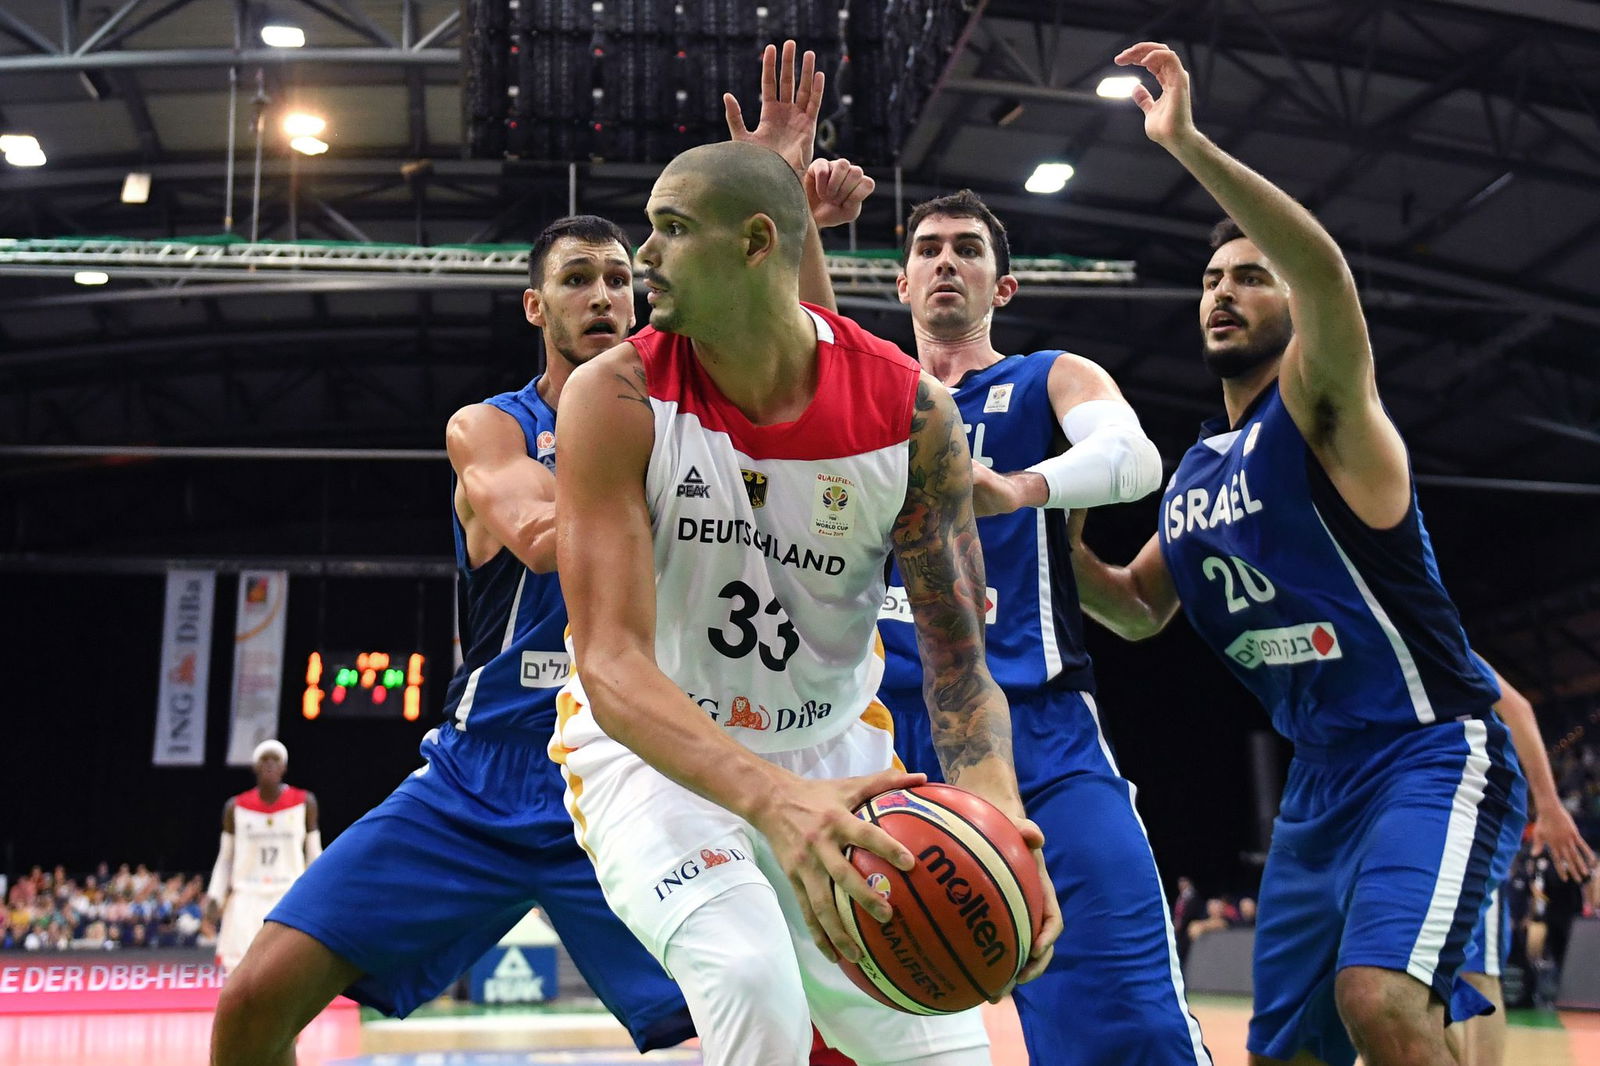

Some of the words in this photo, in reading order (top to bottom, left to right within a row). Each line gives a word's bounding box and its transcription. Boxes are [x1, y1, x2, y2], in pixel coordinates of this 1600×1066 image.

[676, 485, 711, 498] PEAK
[1164, 469, 1263, 544] ISRAEL
[678, 518, 846, 576] DEUTSCHLAND
[816, 521, 836, 530] WORLD
[1202, 555, 1276, 614] 20
[708, 580, 800, 672] 33
[168, 693, 195, 753] ING
[775, 699, 832, 733] DiBa
[261, 846, 279, 866] 17
[653, 860, 700, 902] ING
[917, 845, 1006, 968] molten
[0, 966, 21, 993] E
[22, 965, 85, 993] DER
